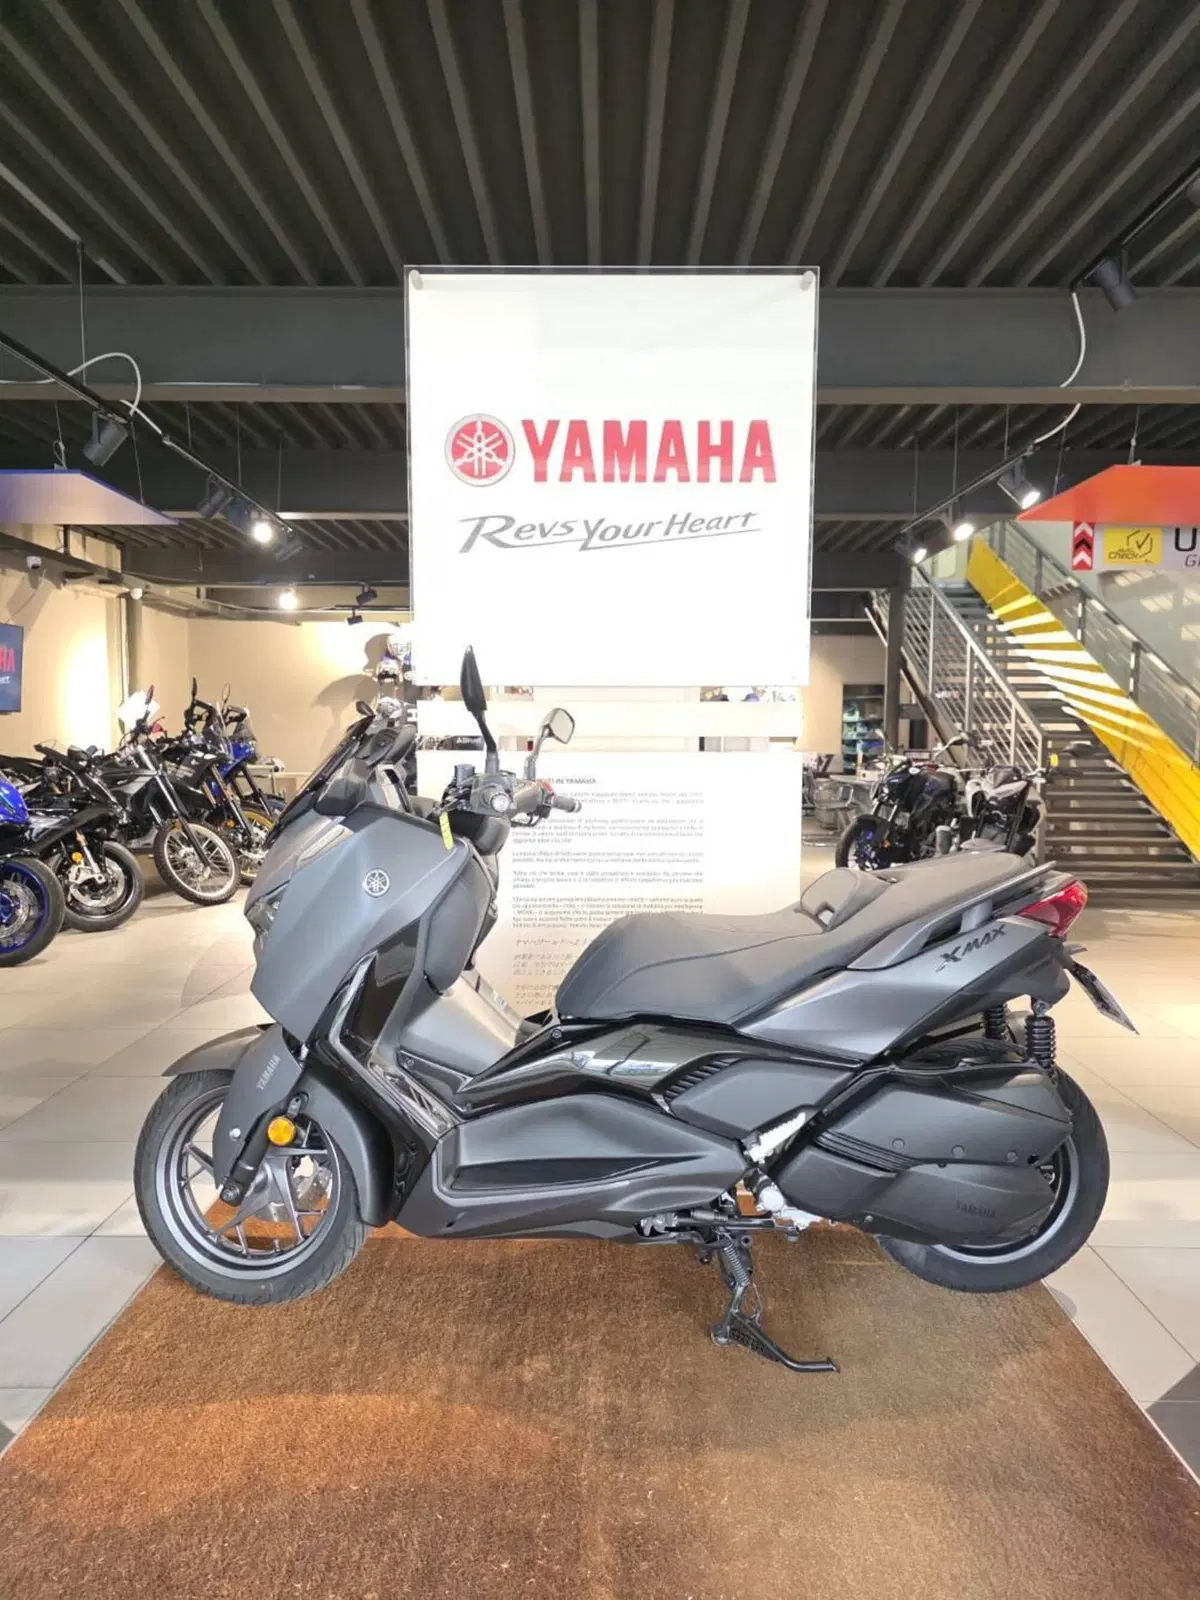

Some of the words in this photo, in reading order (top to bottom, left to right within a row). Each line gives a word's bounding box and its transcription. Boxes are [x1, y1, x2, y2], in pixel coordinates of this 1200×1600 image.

[521, 419, 777, 483] YAMAHA
[458, 515, 578, 553] Revs
[578, 517, 663, 551] Your
[663, 511, 758, 536] Heart
[256, 1054, 281, 1090] YAMAHA
[956, 1201, 996, 1218] YAMAHA
